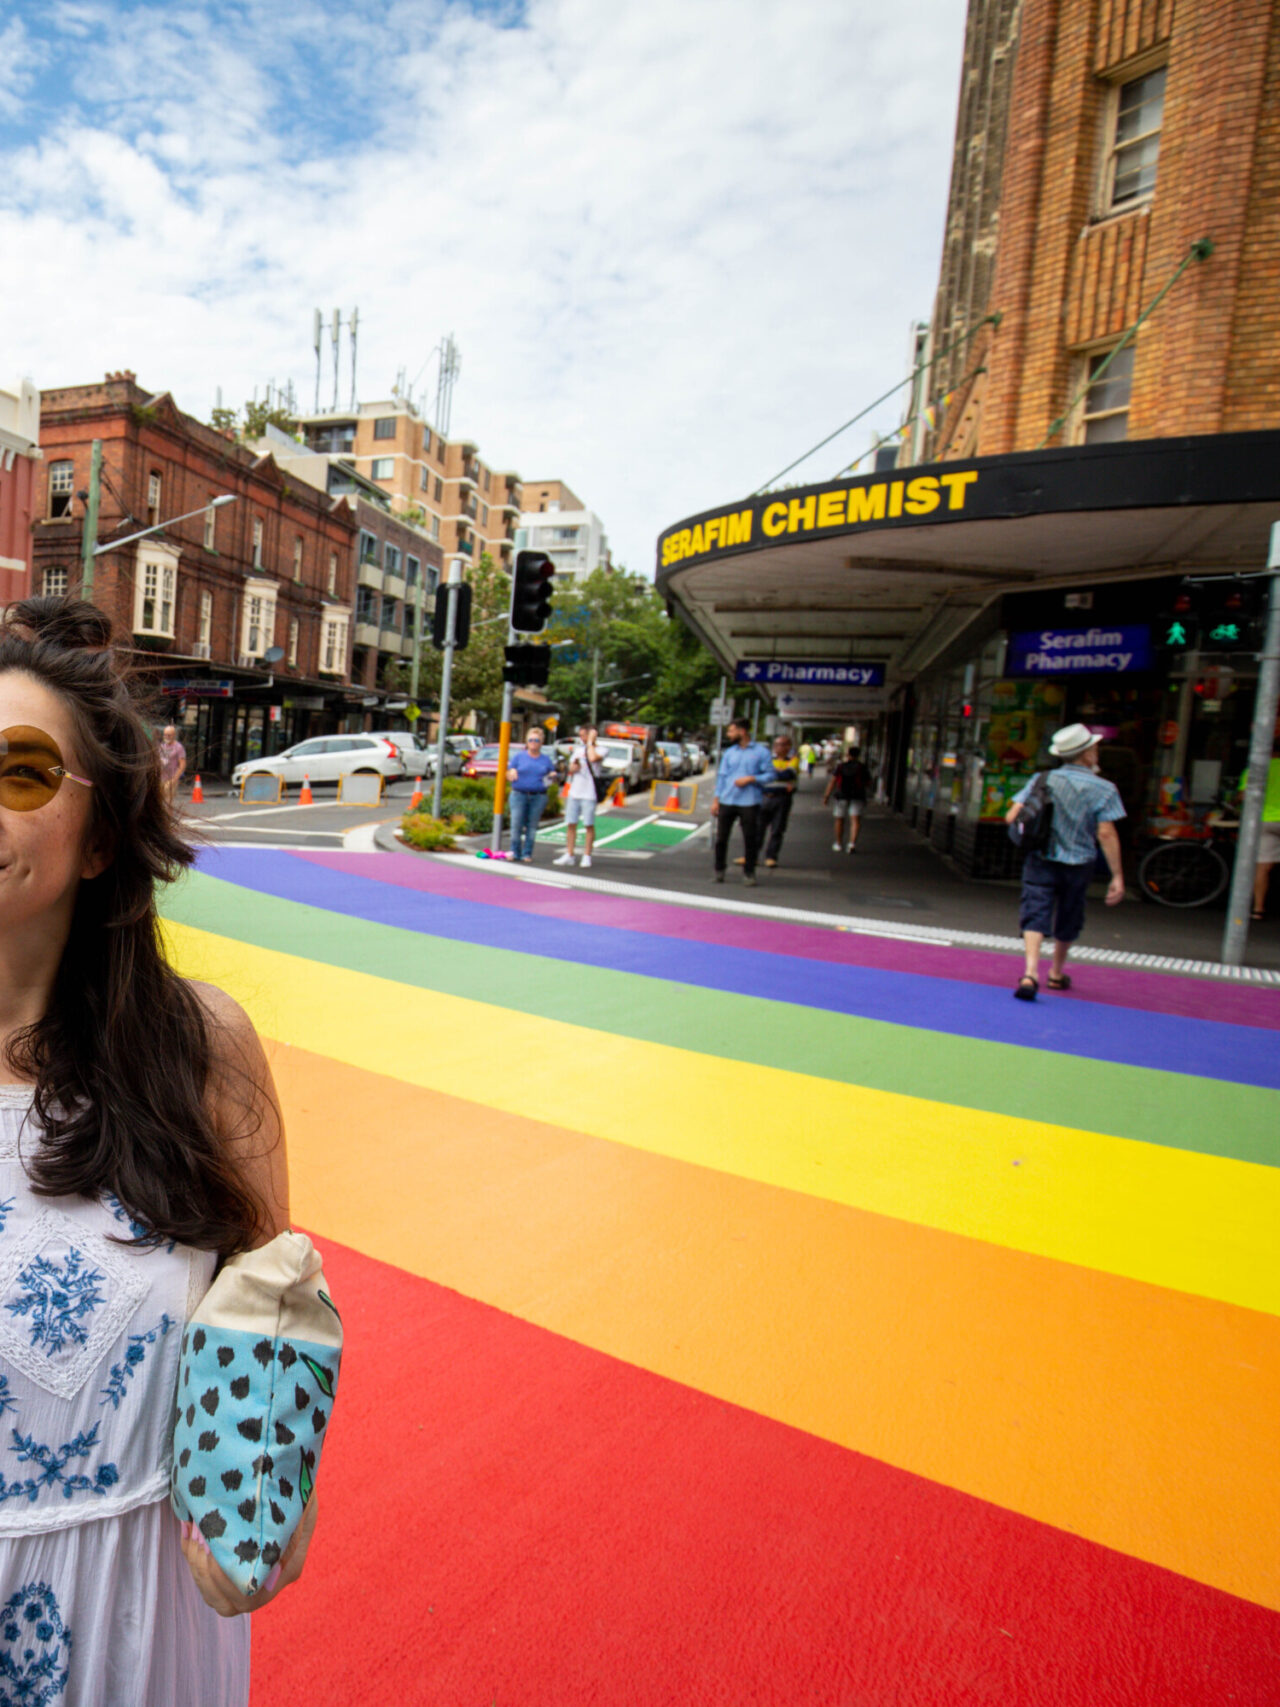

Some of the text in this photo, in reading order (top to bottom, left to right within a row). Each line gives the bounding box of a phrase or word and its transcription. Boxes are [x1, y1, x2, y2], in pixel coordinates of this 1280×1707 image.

[661, 471, 978, 567] SERAFIM CHEMIST
[1039, 629, 1123, 650] Serafim
[1024, 651, 1132, 671] Pharmacy
[767, 663, 873, 684] Pharmacy
